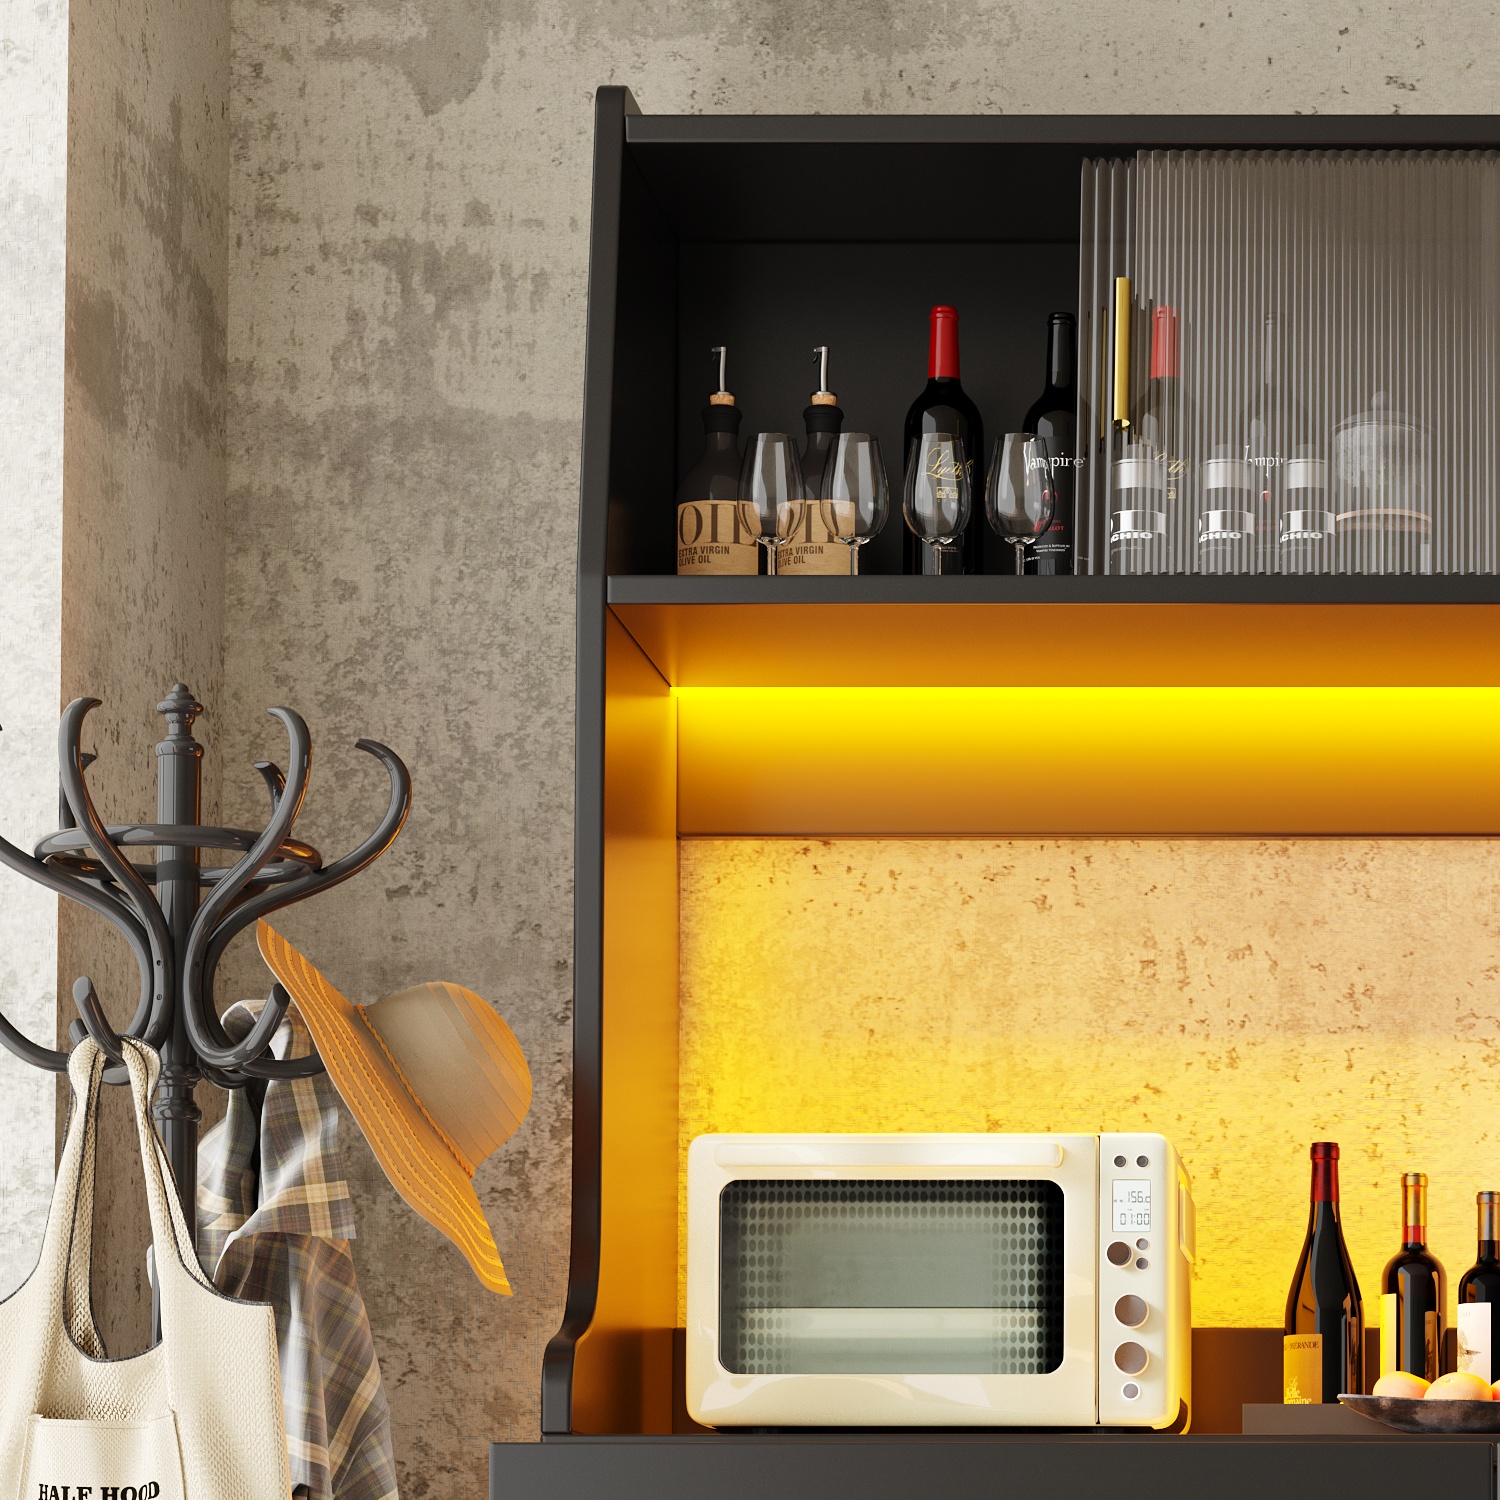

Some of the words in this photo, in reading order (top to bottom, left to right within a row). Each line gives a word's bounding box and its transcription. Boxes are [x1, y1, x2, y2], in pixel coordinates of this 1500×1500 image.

[679, 503, 757, 547] OIL
[1110, 532, 1153, 543] CHIO
[1198, 532, 1242, 543] CHIO
[1280, 532, 1323, 543] CHIO
[678, 547, 698, 558] EXTRA
[700, 546, 730, 555] VIRGIN
[796, 546, 824, 555] VIRGIN
[678, 556, 696, 567] OLIVE
[698, 555, 712, 564] OIL
[798, 555, 806, 564] OIL
[1120, 1213, 1150, 1225] 01:00
